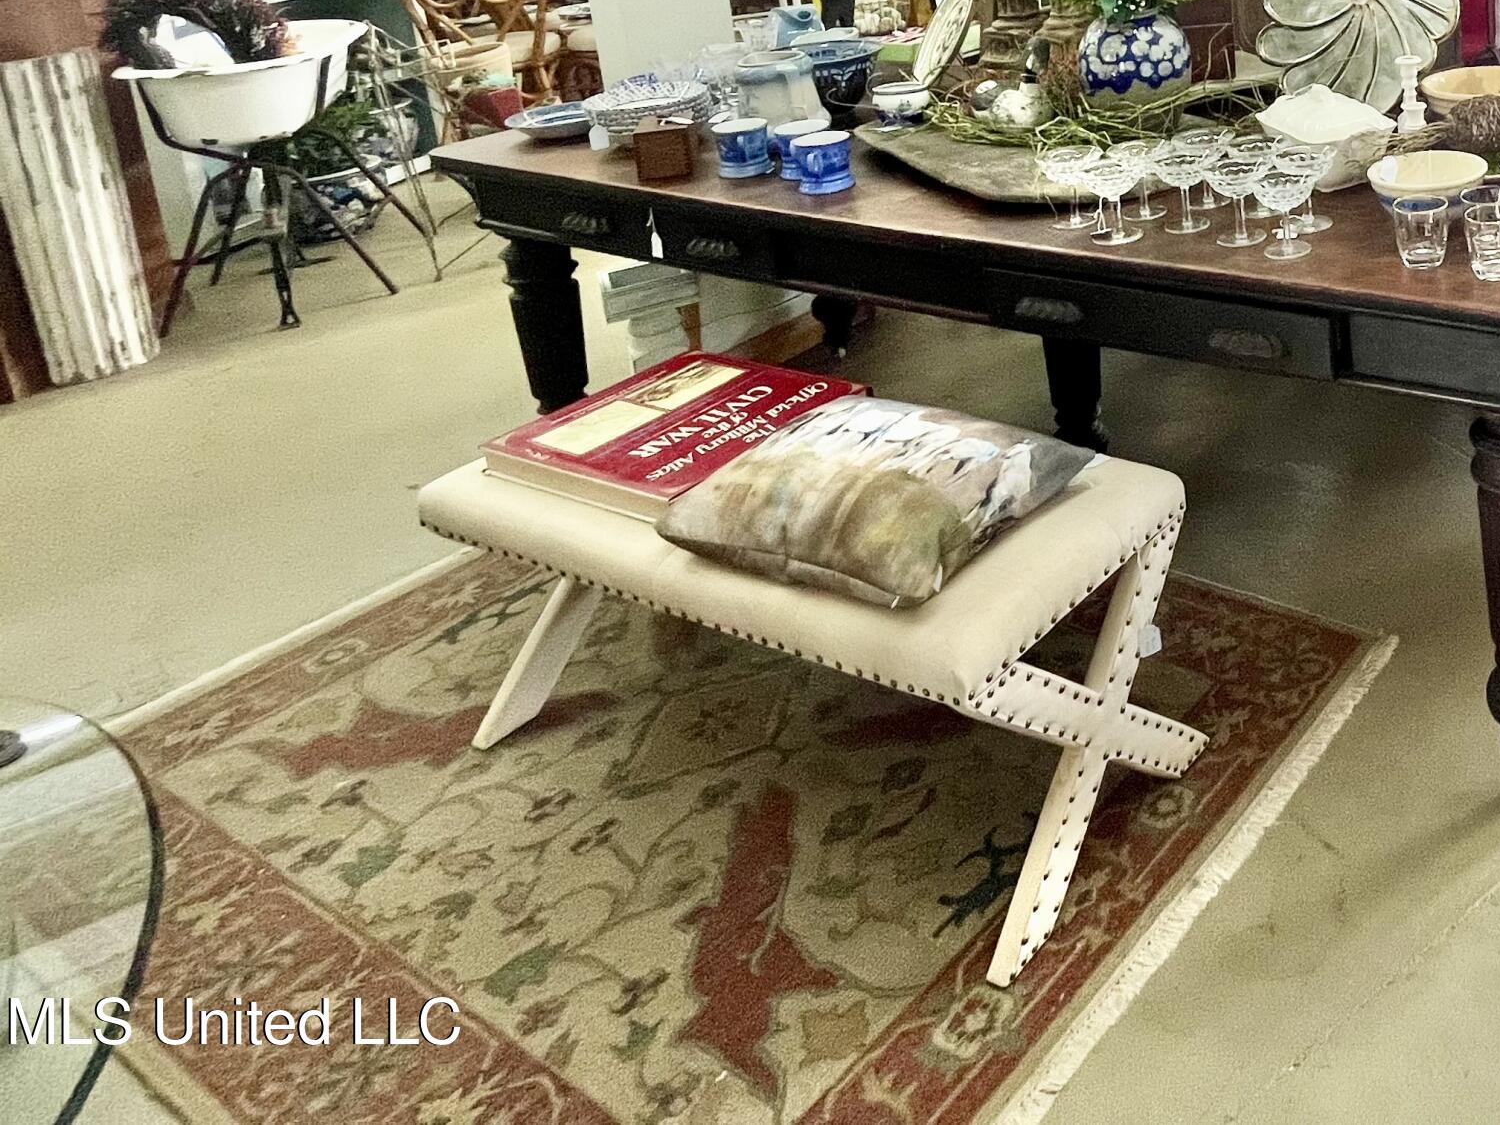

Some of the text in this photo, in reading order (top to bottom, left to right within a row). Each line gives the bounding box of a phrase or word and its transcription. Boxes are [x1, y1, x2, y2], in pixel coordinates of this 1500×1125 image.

[693, 385, 773, 424] CIVIL
[628, 422, 704, 458] WAR
[646, 381, 829, 481] Official Military Atlas
[702, 411, 749, 440] of the
[745, 423, 776, 444] The
